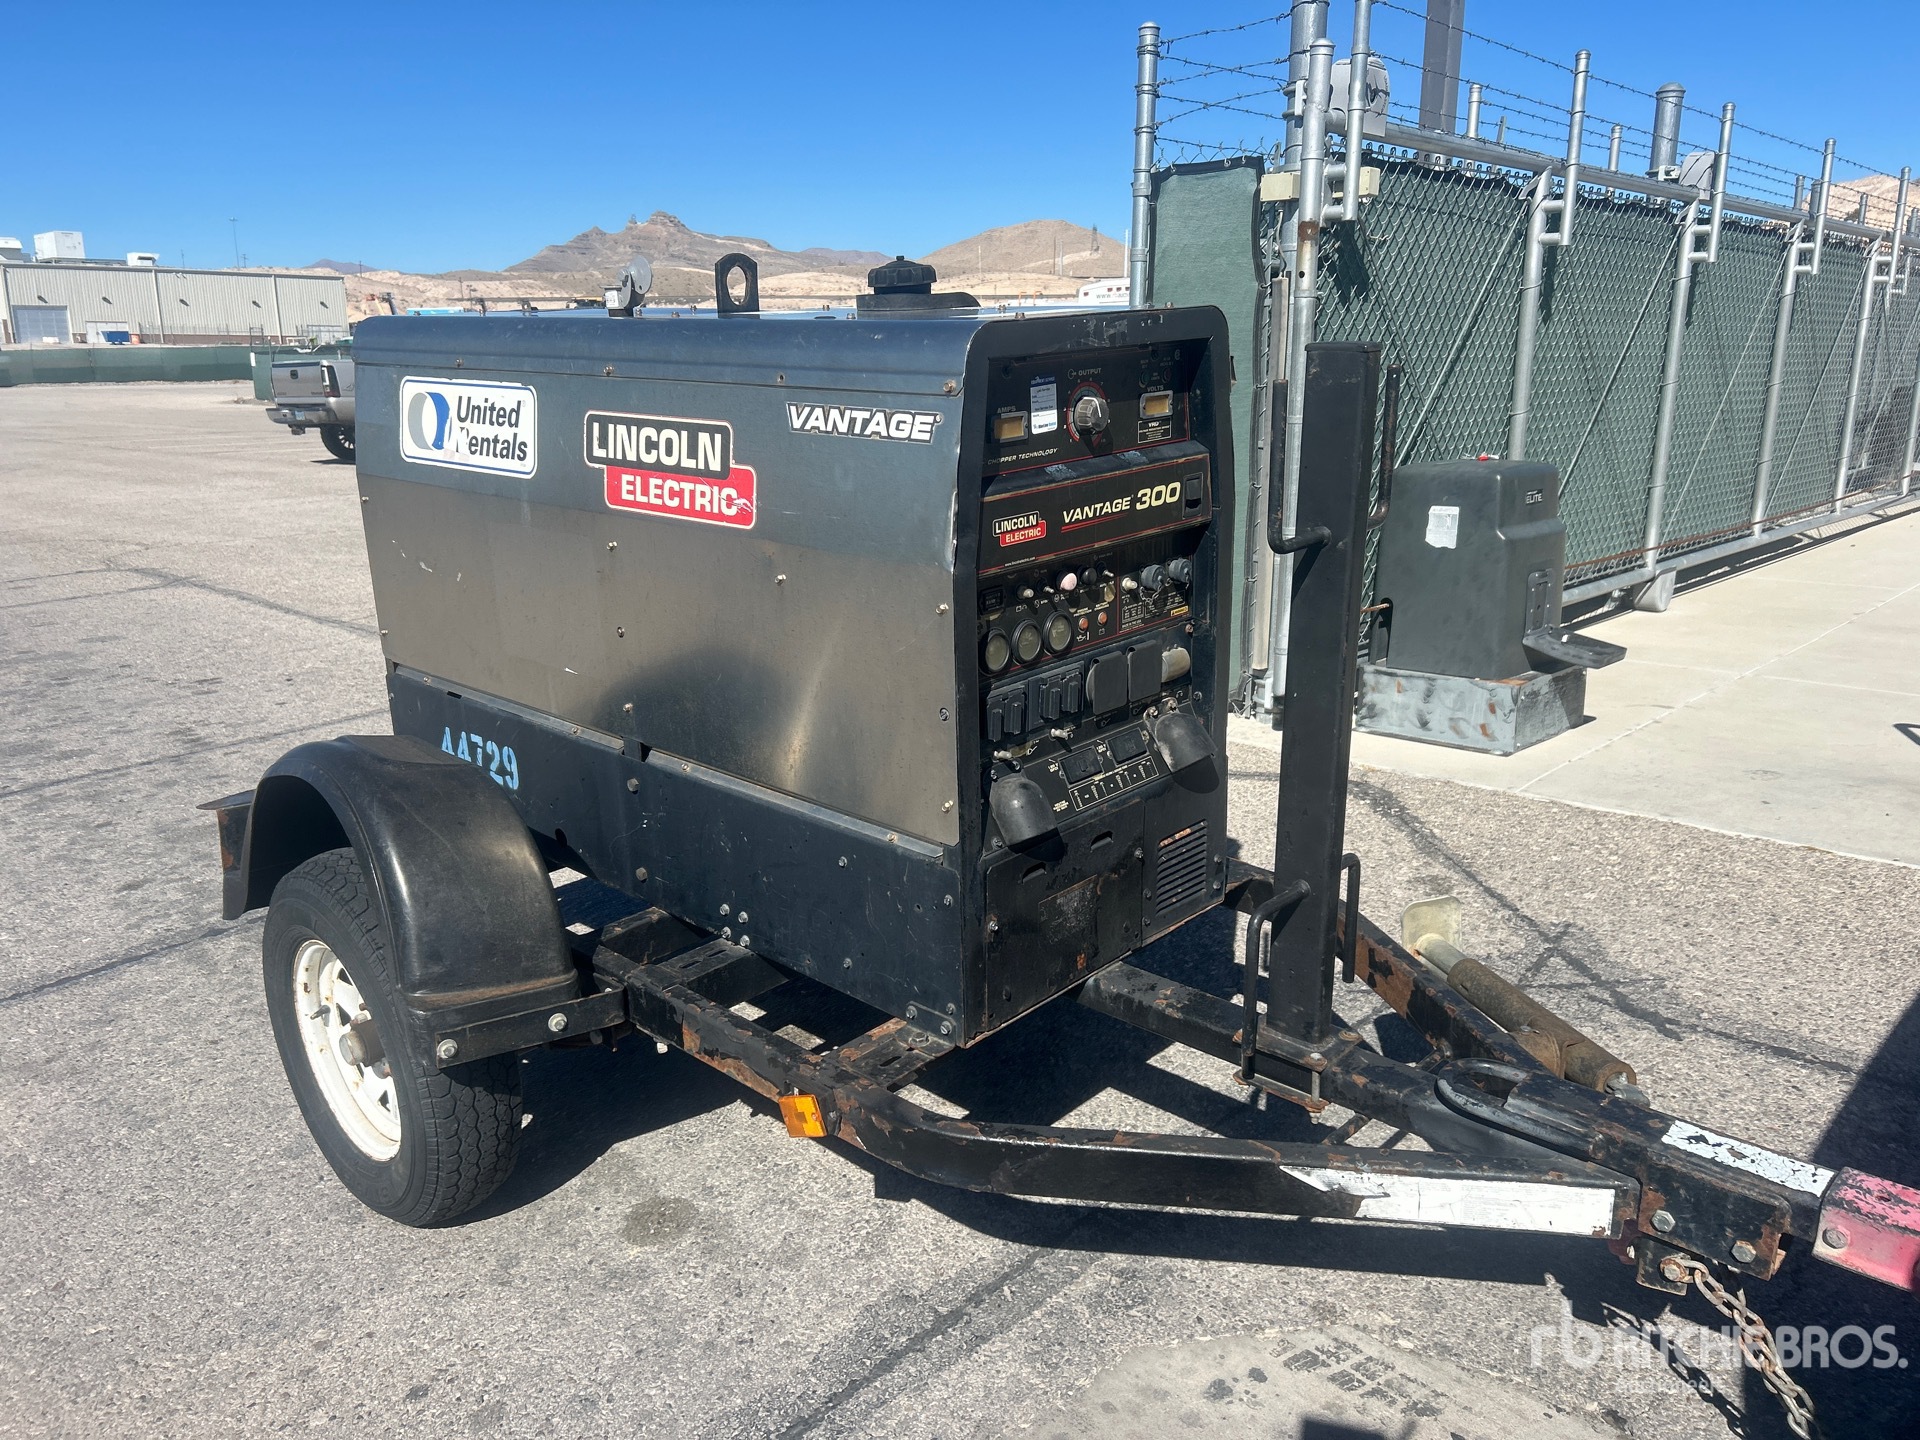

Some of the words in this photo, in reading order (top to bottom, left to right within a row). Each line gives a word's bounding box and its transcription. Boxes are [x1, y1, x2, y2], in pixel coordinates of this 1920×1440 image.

[1078, 368, 1102, 376] OUTPUT
[456, 395, 522, 428] United
[788, 403, 937, 442] VANTAGE
[593, 422, 722, 472] LINCOLN
[987, 454, 1017, 465] CHOPPER
[1018, 447, 1059, 460] TECHNOLOGY
[621, 473, 738, 516] ELECTRIC
[1062, 496, 1132, 523] VANTAGE
[1135, 481, 1181, 511] 300
[1526, 493, 1543, 504] ELITE
[995, 514, 1037, 534] LINCOLN
[1005, 527, 1042, 543] ELECTRIC
